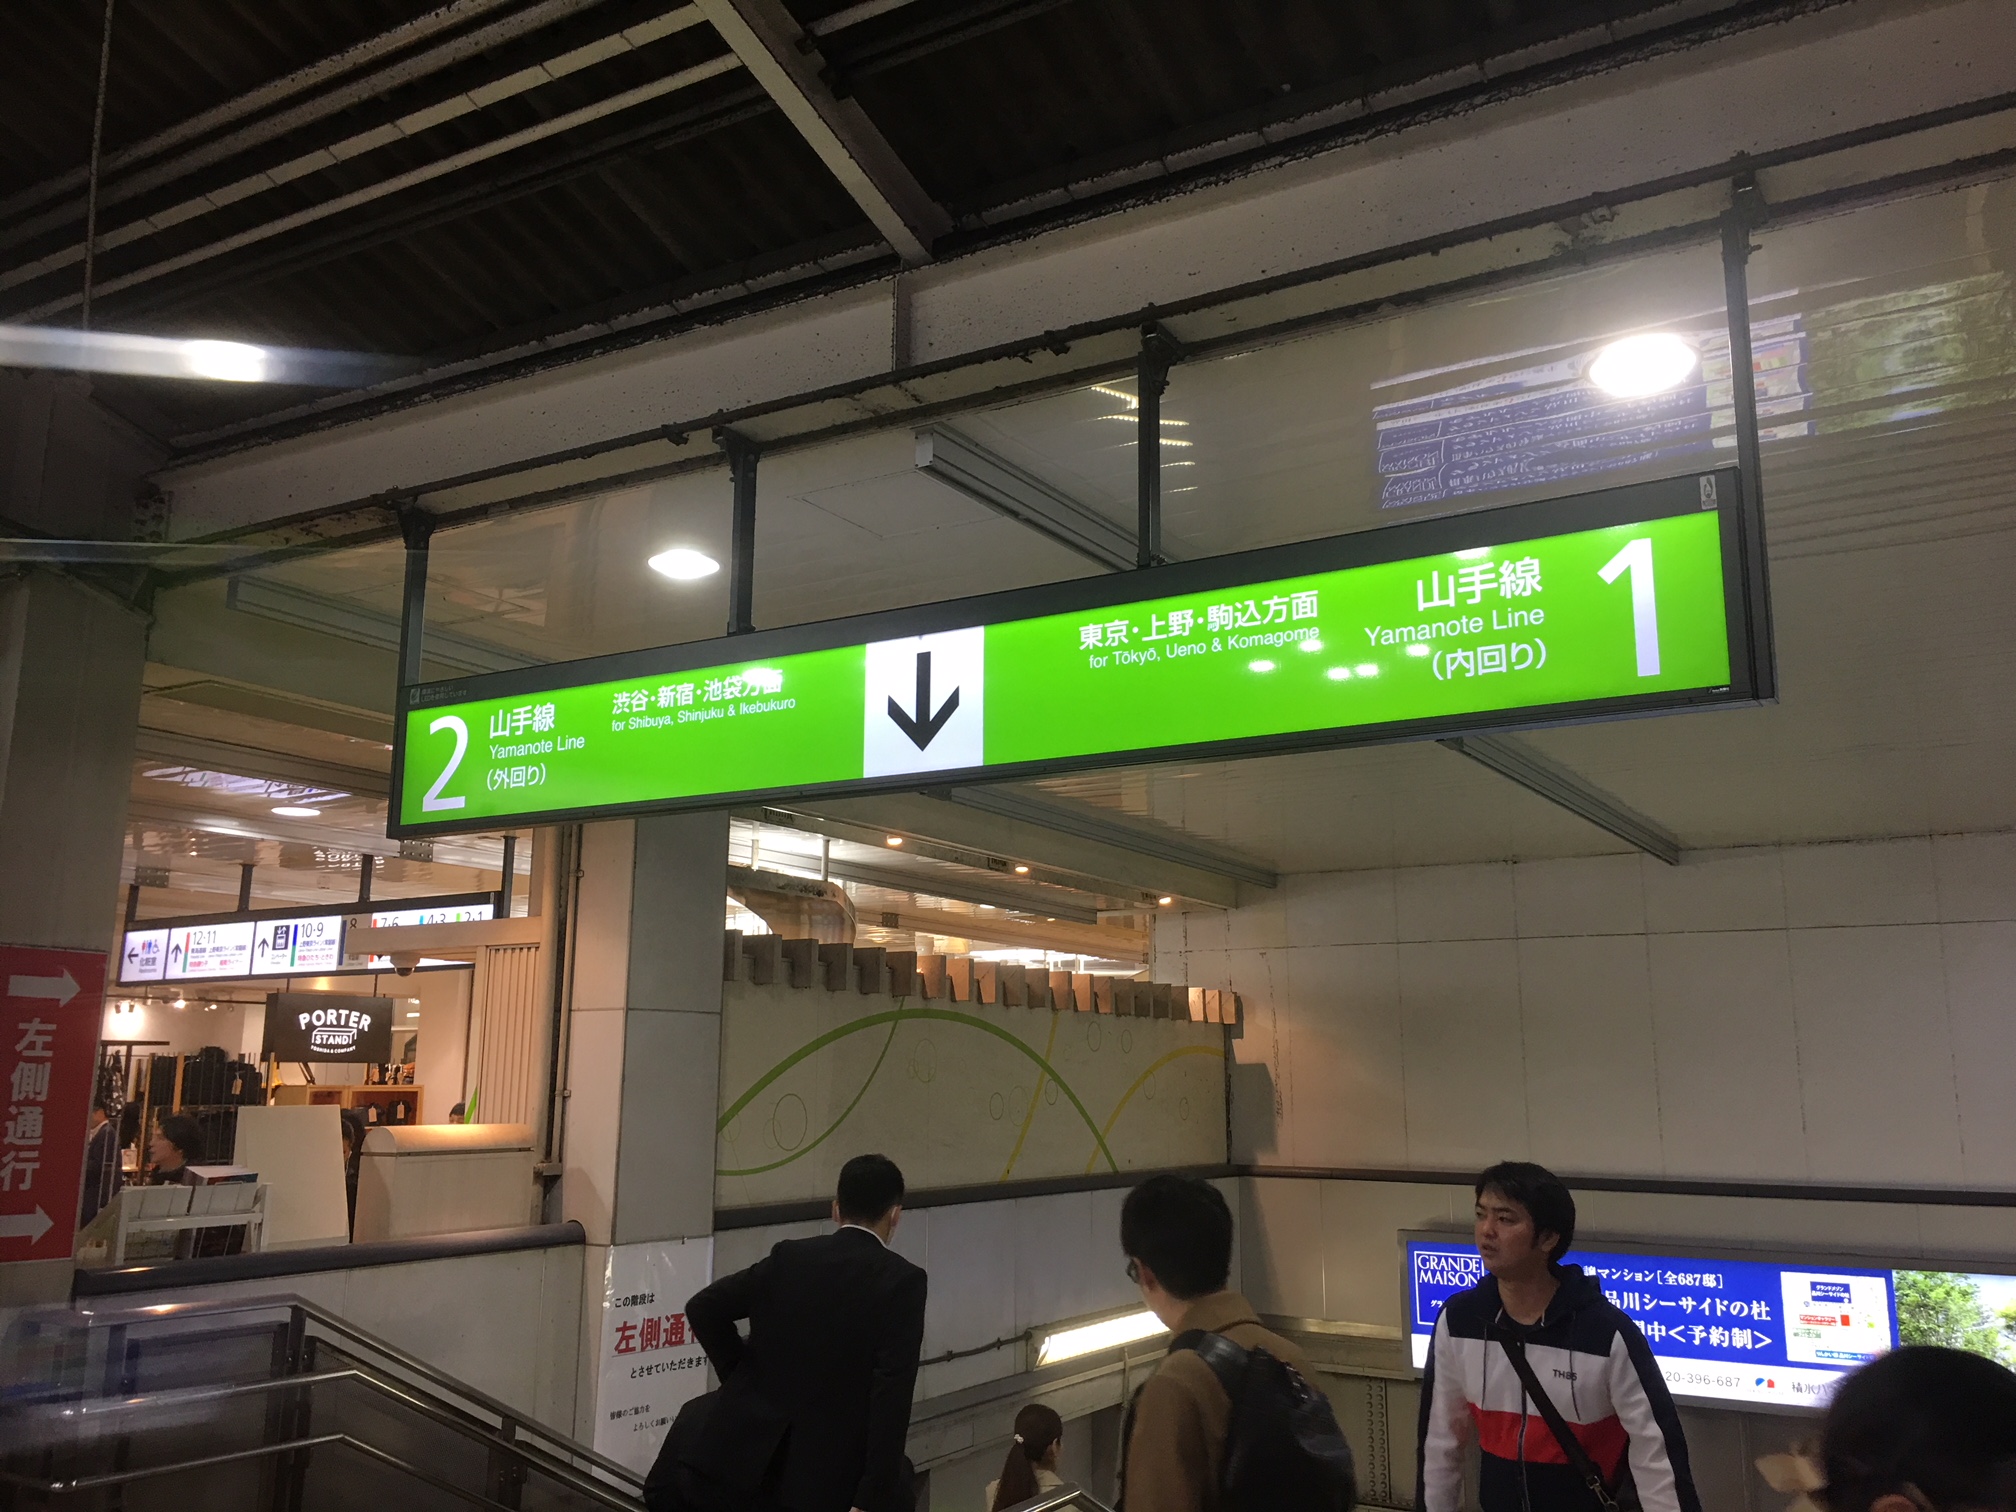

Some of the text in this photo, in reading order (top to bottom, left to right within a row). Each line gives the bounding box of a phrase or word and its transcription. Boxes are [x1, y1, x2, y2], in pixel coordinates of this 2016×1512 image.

[1416, 556, 1543, 611] 山手線
[1078, 590, 1319, 650] 東京・上野・駒込方面
[1597, 537, 1660, 677] 1
[1365, 607, 1545, 647] Yamanote Line
[1089, 626, 1320, 668] for Tōkyō, Ueno & Komagome
[1432, 638, 1547, 680] (内回り)
[612, 669, 783, 715] 渋谷・新宿・池袋方面
[489, 702, 555, 739] 山手線
[611, 698, 796, 732] for Shibuya, Shinjuku & Ikebukuro
[422, 715, 469, 812] 2
[489, 735, 585, 759] Yamanote Line
[487, 763, 546, 791] (外回り)
[299, 1009, 371, 1031] PORTER
[315, 1035, 349, 1045] STAND
[0, 1018, 57, 1191] 左側通行
[1418, 1255, 1480, 1272] GRANDE
[1419, 1270, 1480, 1286] MAISON
[615, 1292, 655, 1308] この階段は
[614, 1313, 698, 1354] 左側通
[610, 1404, 650, 1420] 皆様のご協力を
